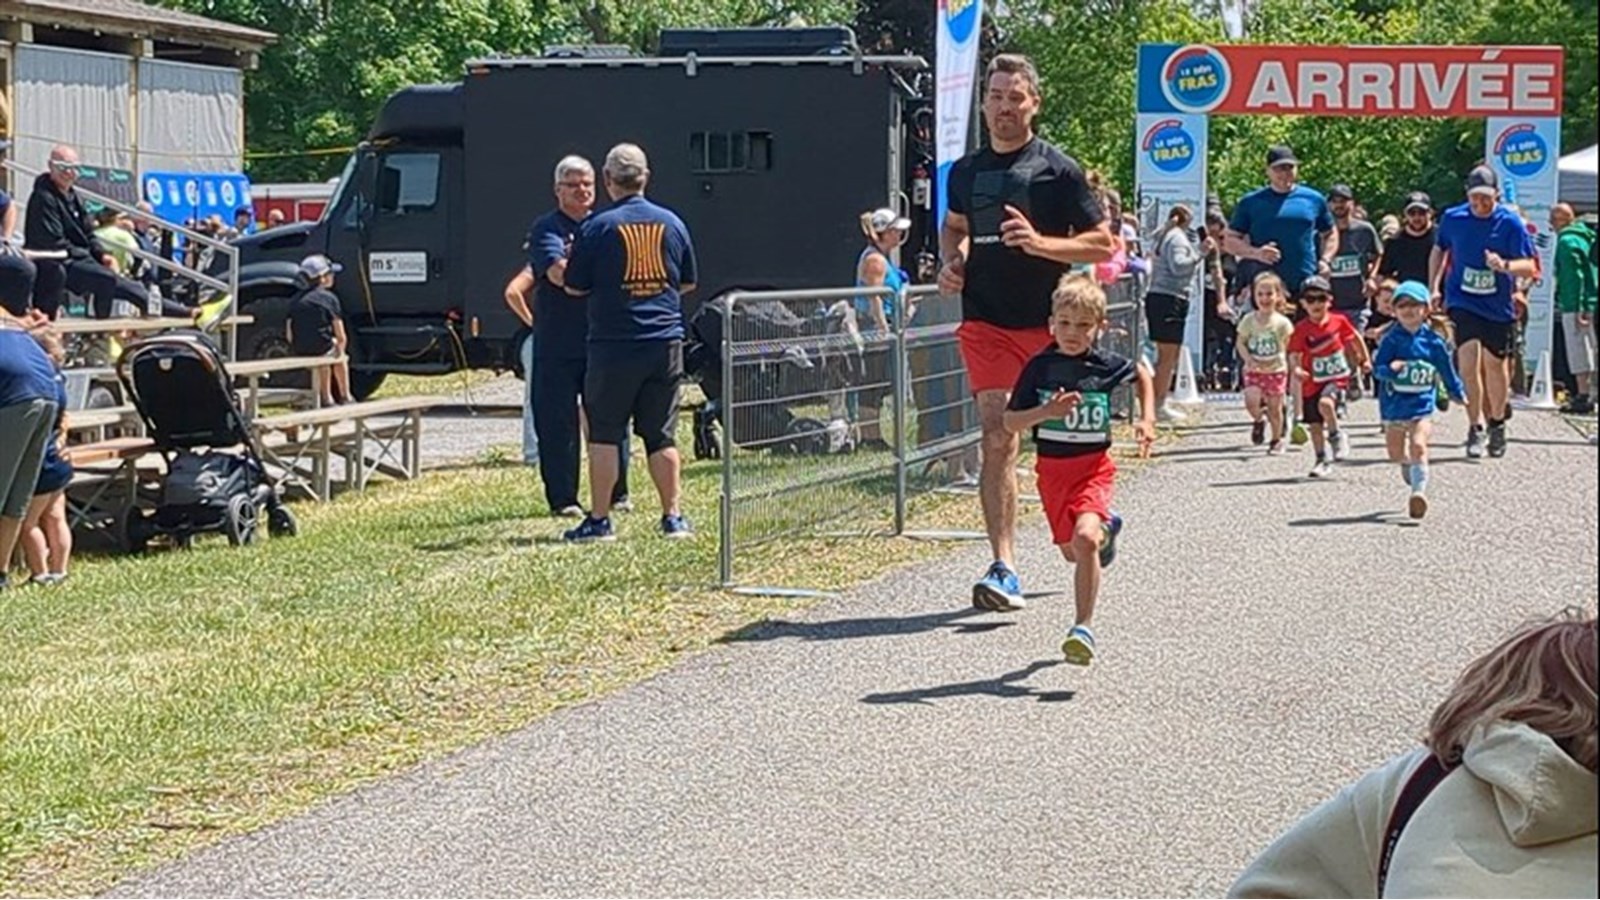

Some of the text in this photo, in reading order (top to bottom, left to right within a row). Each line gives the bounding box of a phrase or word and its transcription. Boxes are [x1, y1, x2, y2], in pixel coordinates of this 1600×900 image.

[1178, 73, 1217, 91] FRAS
[1245, 49, 1556, 110] ARRIVÉE
[1152, 145, 1190, 162] FRAS
[1504, 149, 1542, 166] FRAS
[1065, 405, 1105, 430] 019
